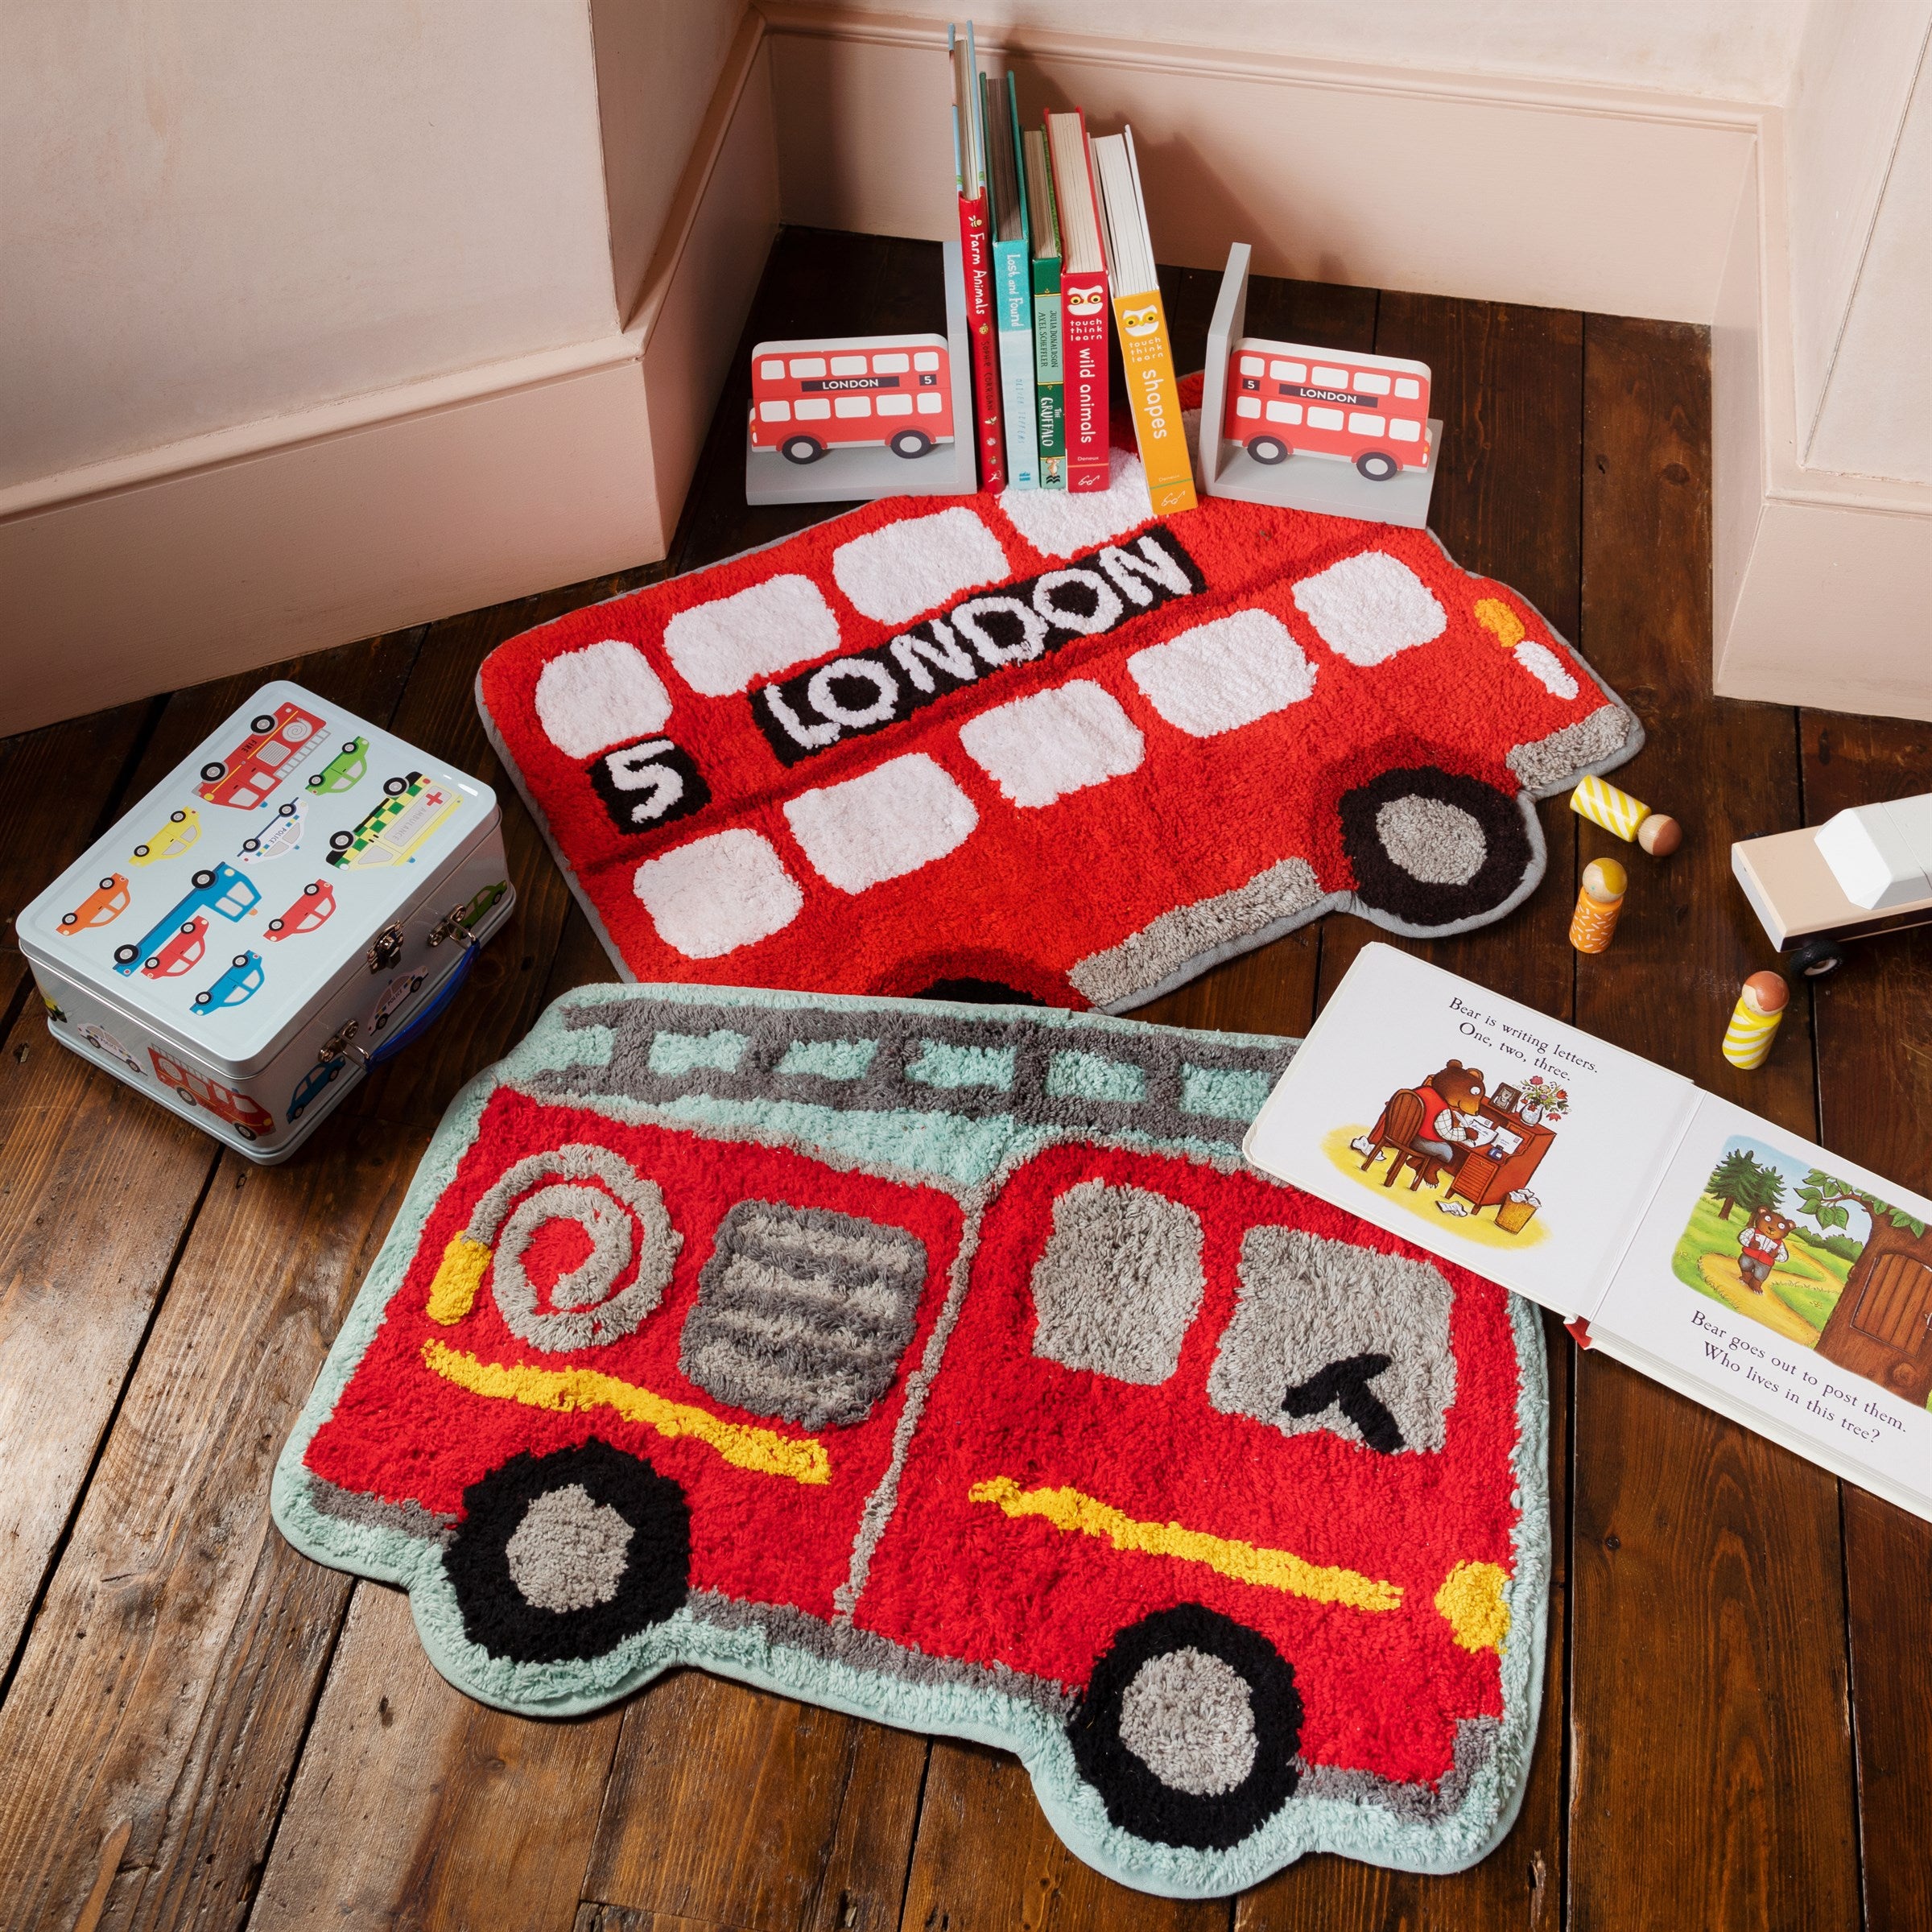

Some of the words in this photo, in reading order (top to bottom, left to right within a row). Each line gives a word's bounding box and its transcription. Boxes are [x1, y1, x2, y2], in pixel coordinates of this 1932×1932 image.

[970, 233, 985, 265] Farm
[1006, 254, 1021, 278] Lost
[972, 270, 989, 315] Animals
[1009, 279, 1019, 295] and
[1009, 297, 1025, 328] Found
[1038, 312, 1046, 331] AXEL
[1050, 310, 1058, 329] JULIA
[1070, 318, 1102, 326] touch
[1070, 325, 1103, 333] think
[1129, 336, 1161, 348] touch
[1039, 331, 1048, 368] SCHEFFLER
[1050, 330, 1059, 368] DONALDSON
[1131, 344, 1162, 355] think
[1132, 353, 1164, 363] learn
[1080, 348, 1096, 378] wild
[822, 378, 879, 390] LONDON
[924, 376, 932, 385] 5
[1247, 381, 1255, 389] 5
[1142, 369, 1167, 440] shapes
[1299, 388, 1357, 404] LONDON
[1040, 397, 1054, 447] GRUFFALO
[1080, 384, 1096, 444] animals
[766, 535, 1193, 749] LONDON
[241, 738, 258, 753] FIRE
[605, 738, 684, 824] 5
[269, 828, 287, 844] POLICE
[392, 807, 427, 841] AMBULANCE
[387, 989, 402, 1006] POLICE
[1449, 997, 1481, 1020] Bear
[1484, 1015, 1497, 1027] is
[1502, 1024, 1549, 1054] writing
[1553, 1044, 1598, 1073] letters.
[1459, 1022, 1492, 1047] One,
[1499, 1042, 1527, 1063] two,
[1534, 1057, 1571, 1081] three.
[1690, 1310, 1727, 1339] Bear
[1728, 1336, 1766, 1359] goes
[1771, 1356, 1798, 1376] out
[1802, 1371, 1818, 1386] to
[1822, 1384, 1858, 1407] post
[1864, 1402, 1907, 1433] them.
[1703, 1340, 1740, 1373] Who
[1745, 1366, 1780, 1393] lives
[1785, 1389, 1800, 1404] in
[1806, 1399, 1835, 1422] this
[1841, 1417, 1880, 1443] tree?
